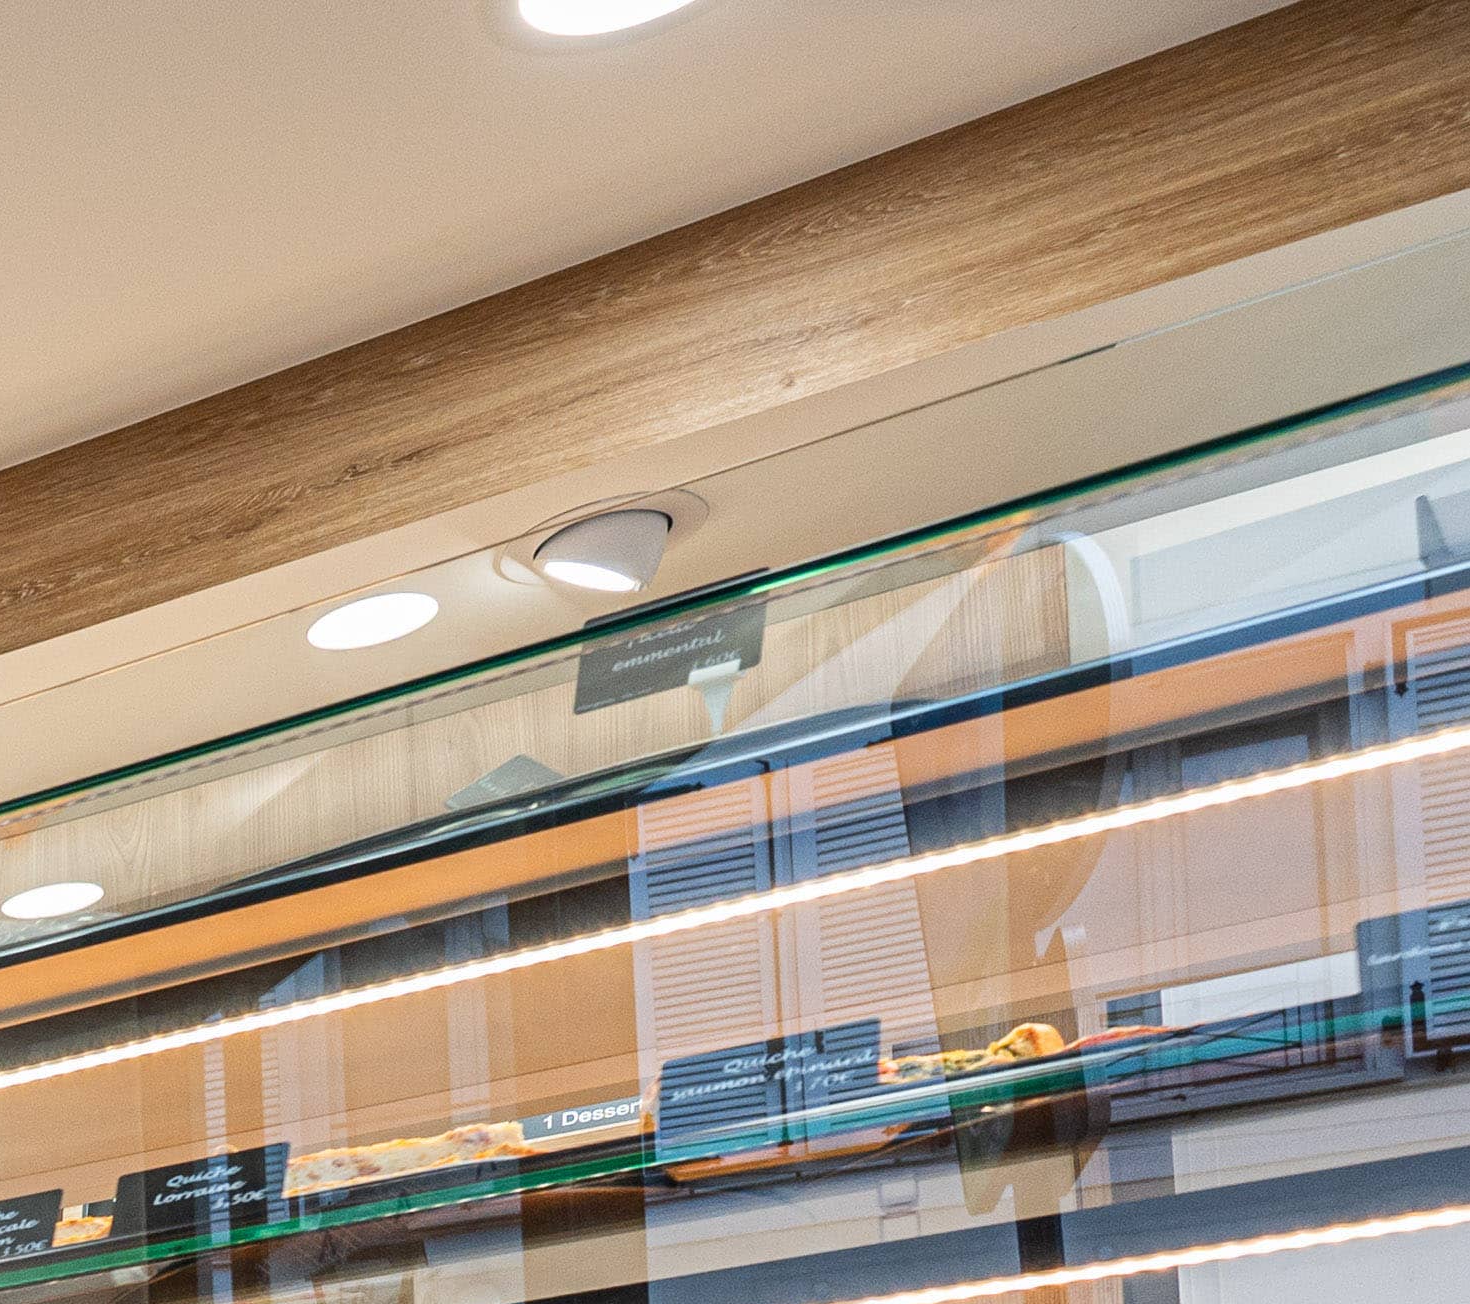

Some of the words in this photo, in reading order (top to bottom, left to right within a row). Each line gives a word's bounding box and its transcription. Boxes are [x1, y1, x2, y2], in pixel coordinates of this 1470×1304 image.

[612, 629, 725, 672] emmental
[722, 1046, 818, 1074] Quiche
[670, 1073, 768, 1102] saumon
[542, 1116, 553, 1131] 1
[166, 1165, 243, 1190] Quiche
[152, 1180, 247, 1207] Lorraine
